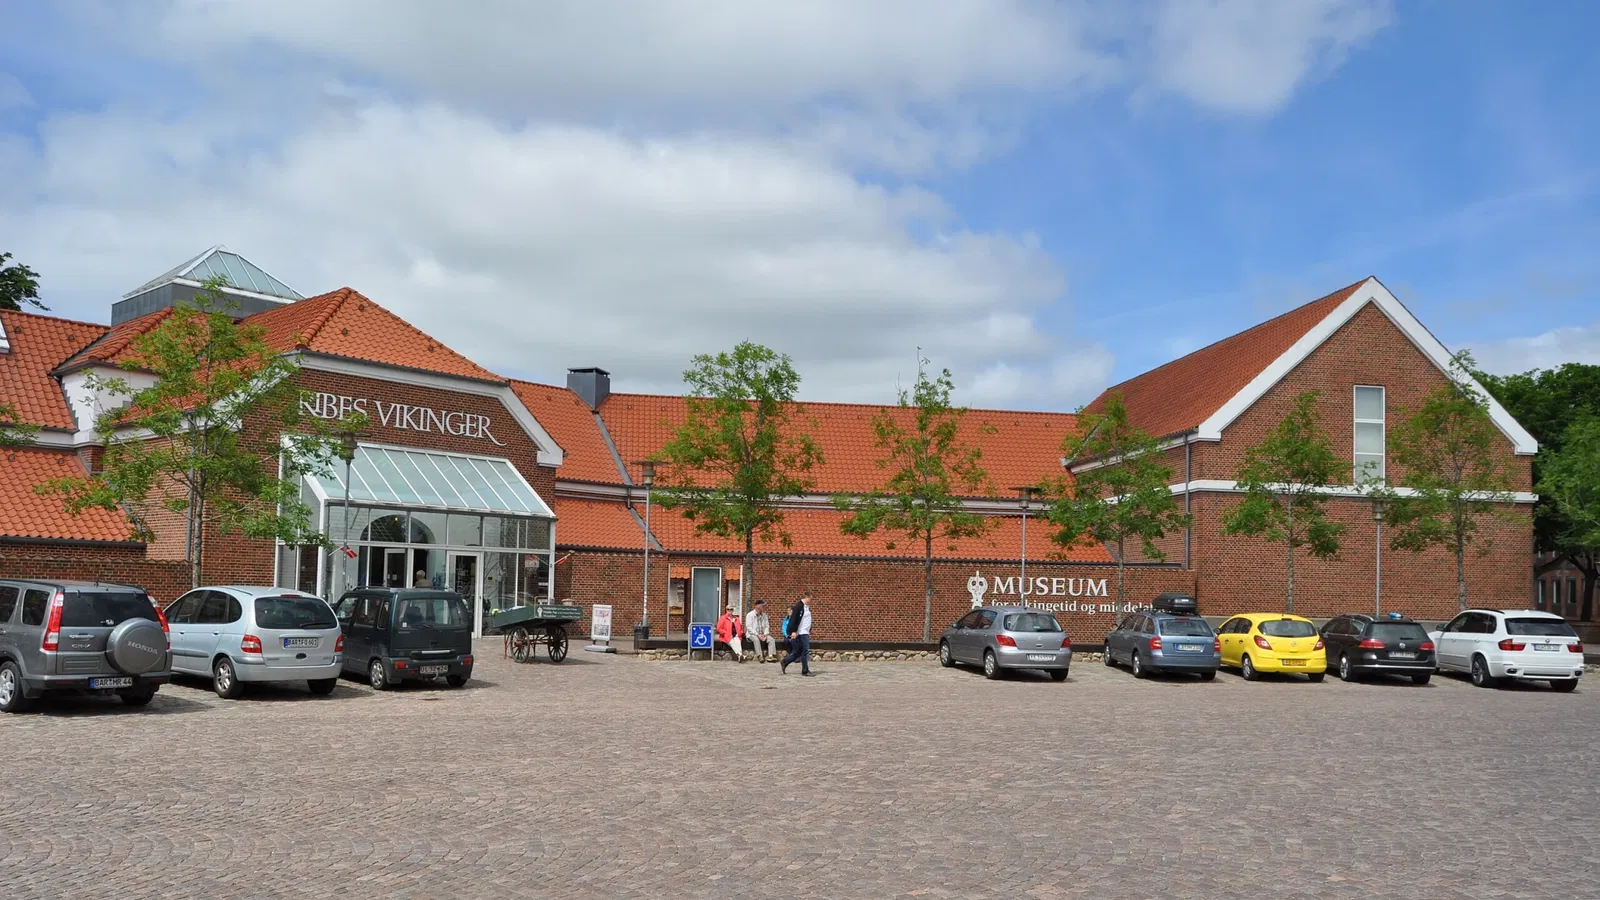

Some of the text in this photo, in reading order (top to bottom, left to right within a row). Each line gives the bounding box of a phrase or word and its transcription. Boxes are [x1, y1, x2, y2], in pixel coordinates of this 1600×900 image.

[373, 400, 507, 446] VIKINGER
[992, 577, 1109, 597] MUSEUM
[991, 598, 1009, 607] for
[1013, 600, 1077, 613] vkingetid
[1081, 604, 1096, 614] og
[127, 641, 158, 654] HONDA
[95, 678, 109, 687] BAR
[112, 678, 122, 686] MR
